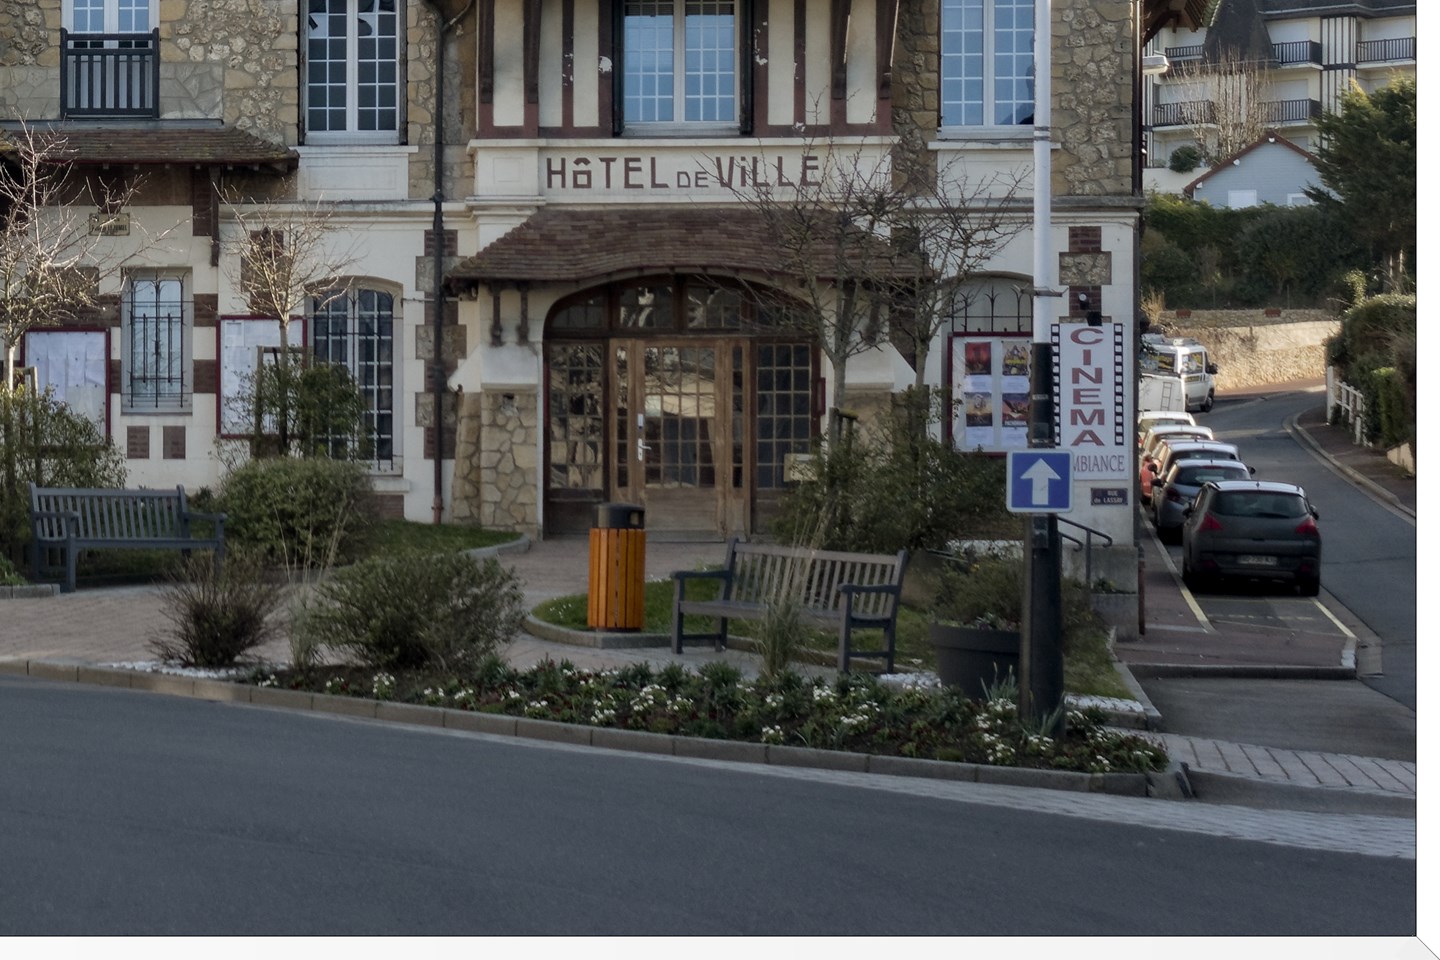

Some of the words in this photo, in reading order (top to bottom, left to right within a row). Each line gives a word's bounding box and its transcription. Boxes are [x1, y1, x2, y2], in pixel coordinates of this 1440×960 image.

[676, 171, 710, 189] DE
[1070, 328, 1105, 446] CINEMA
[1073, 455, 1125, 472] MBIANCE
